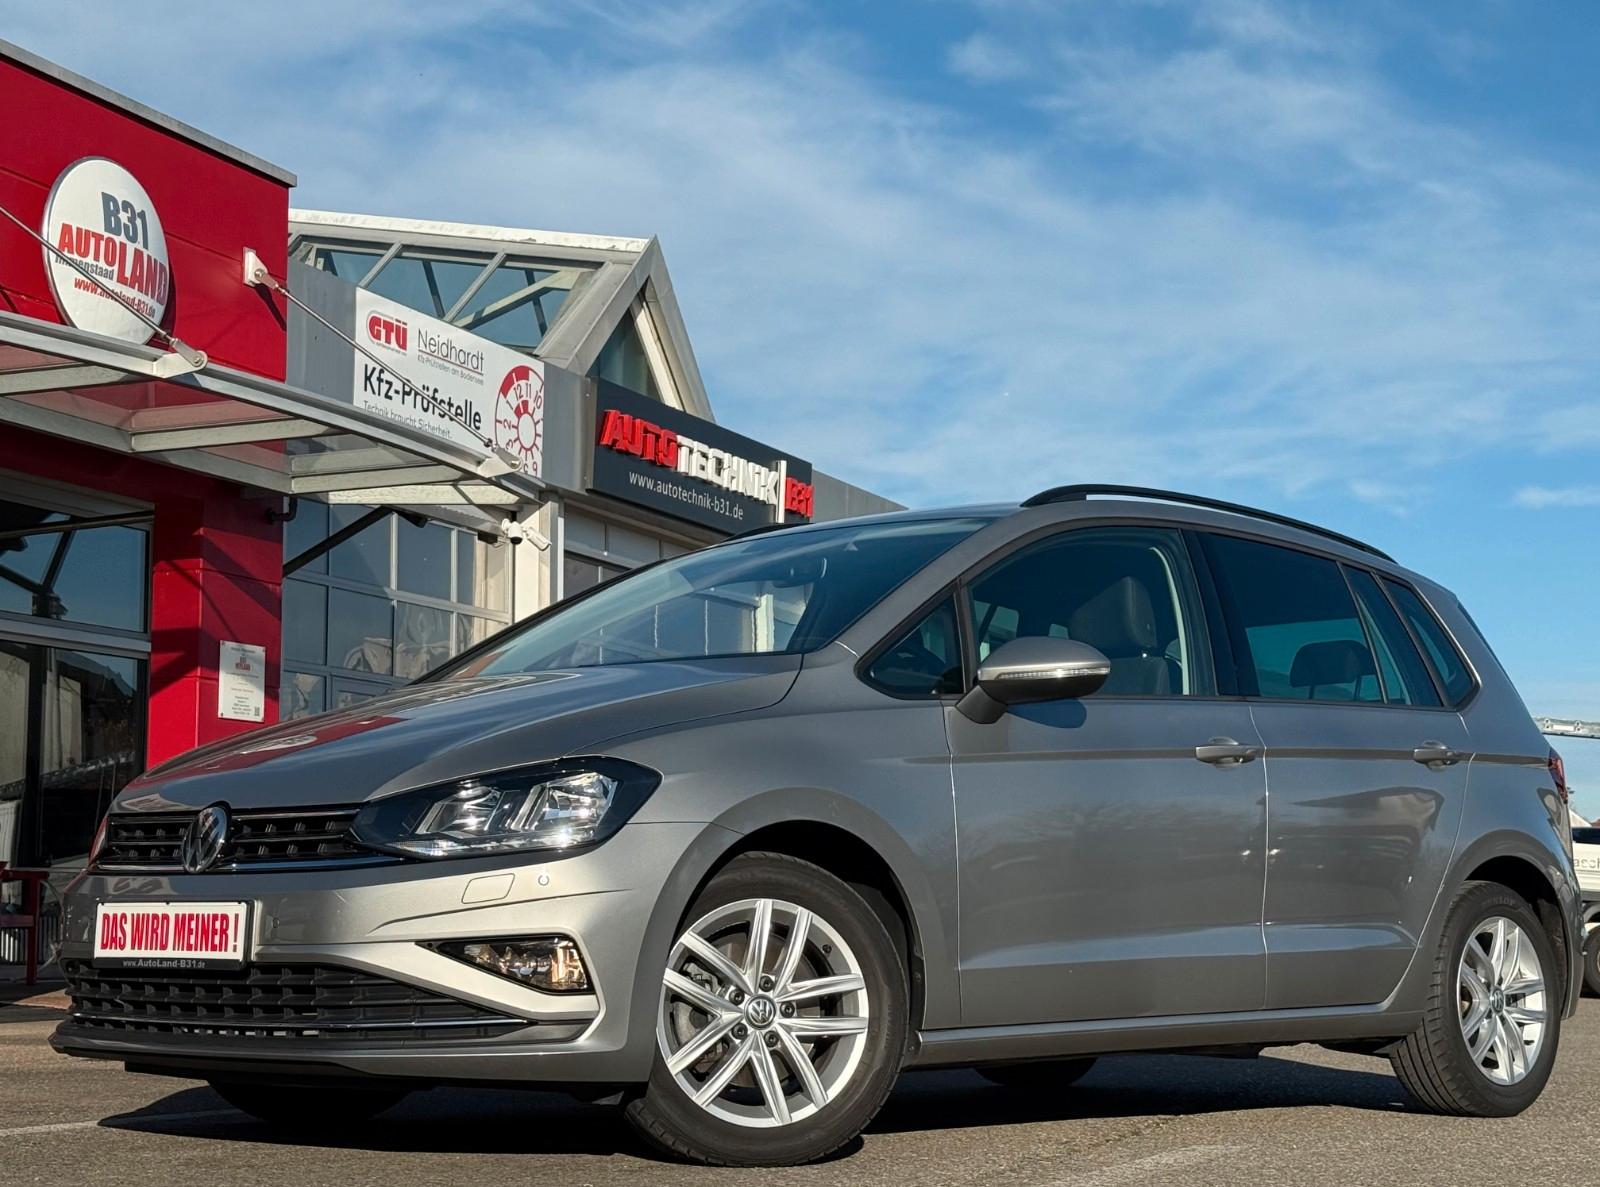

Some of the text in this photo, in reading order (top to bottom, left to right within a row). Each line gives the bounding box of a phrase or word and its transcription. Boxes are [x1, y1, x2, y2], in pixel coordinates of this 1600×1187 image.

[101, 191, 149, 250] B31
[58, 222, 169, 306] AUTOLAND
[368, 315, 408, 352] GTÜ
[417, 327, 484, 372] Neidhardt
[363, 363, 482, 431] Kfz-Prüfstelle
[363, 400, 390, 417] Technik
[628, 471, 744, 520] www.autotechnik-b31.de
[100, 912, 240, 953] DAS WIRD MEINER !
[122, 958, 206, 969] www.AutoLand-B31.de
